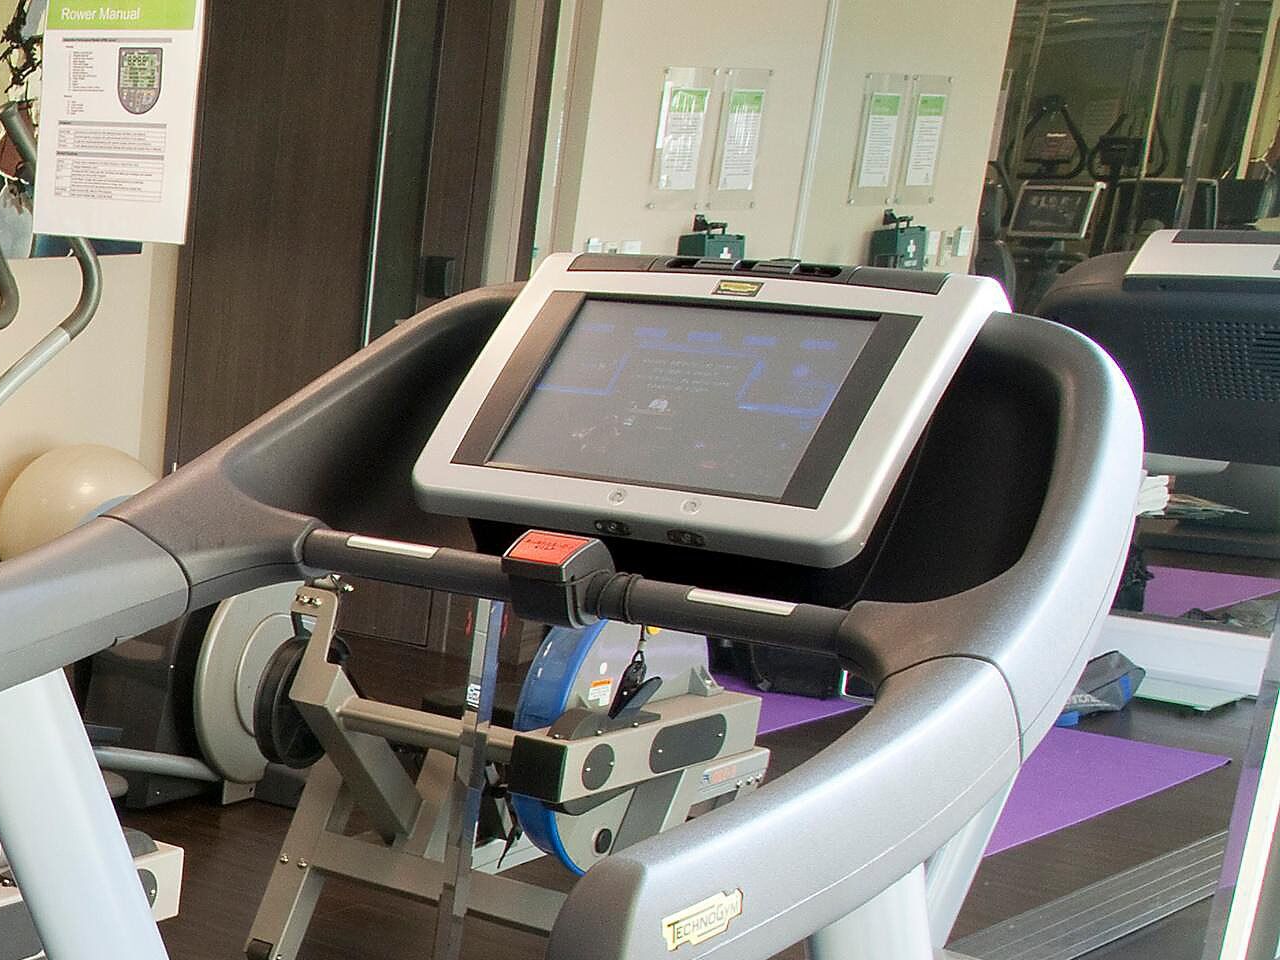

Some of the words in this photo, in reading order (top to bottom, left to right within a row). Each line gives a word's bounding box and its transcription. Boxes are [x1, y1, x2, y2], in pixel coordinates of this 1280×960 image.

[61, 8, 96, 20] Rower
[99, 7, 141, 20] Manual
[666, 900, 737, 945] TECHNOGYM
